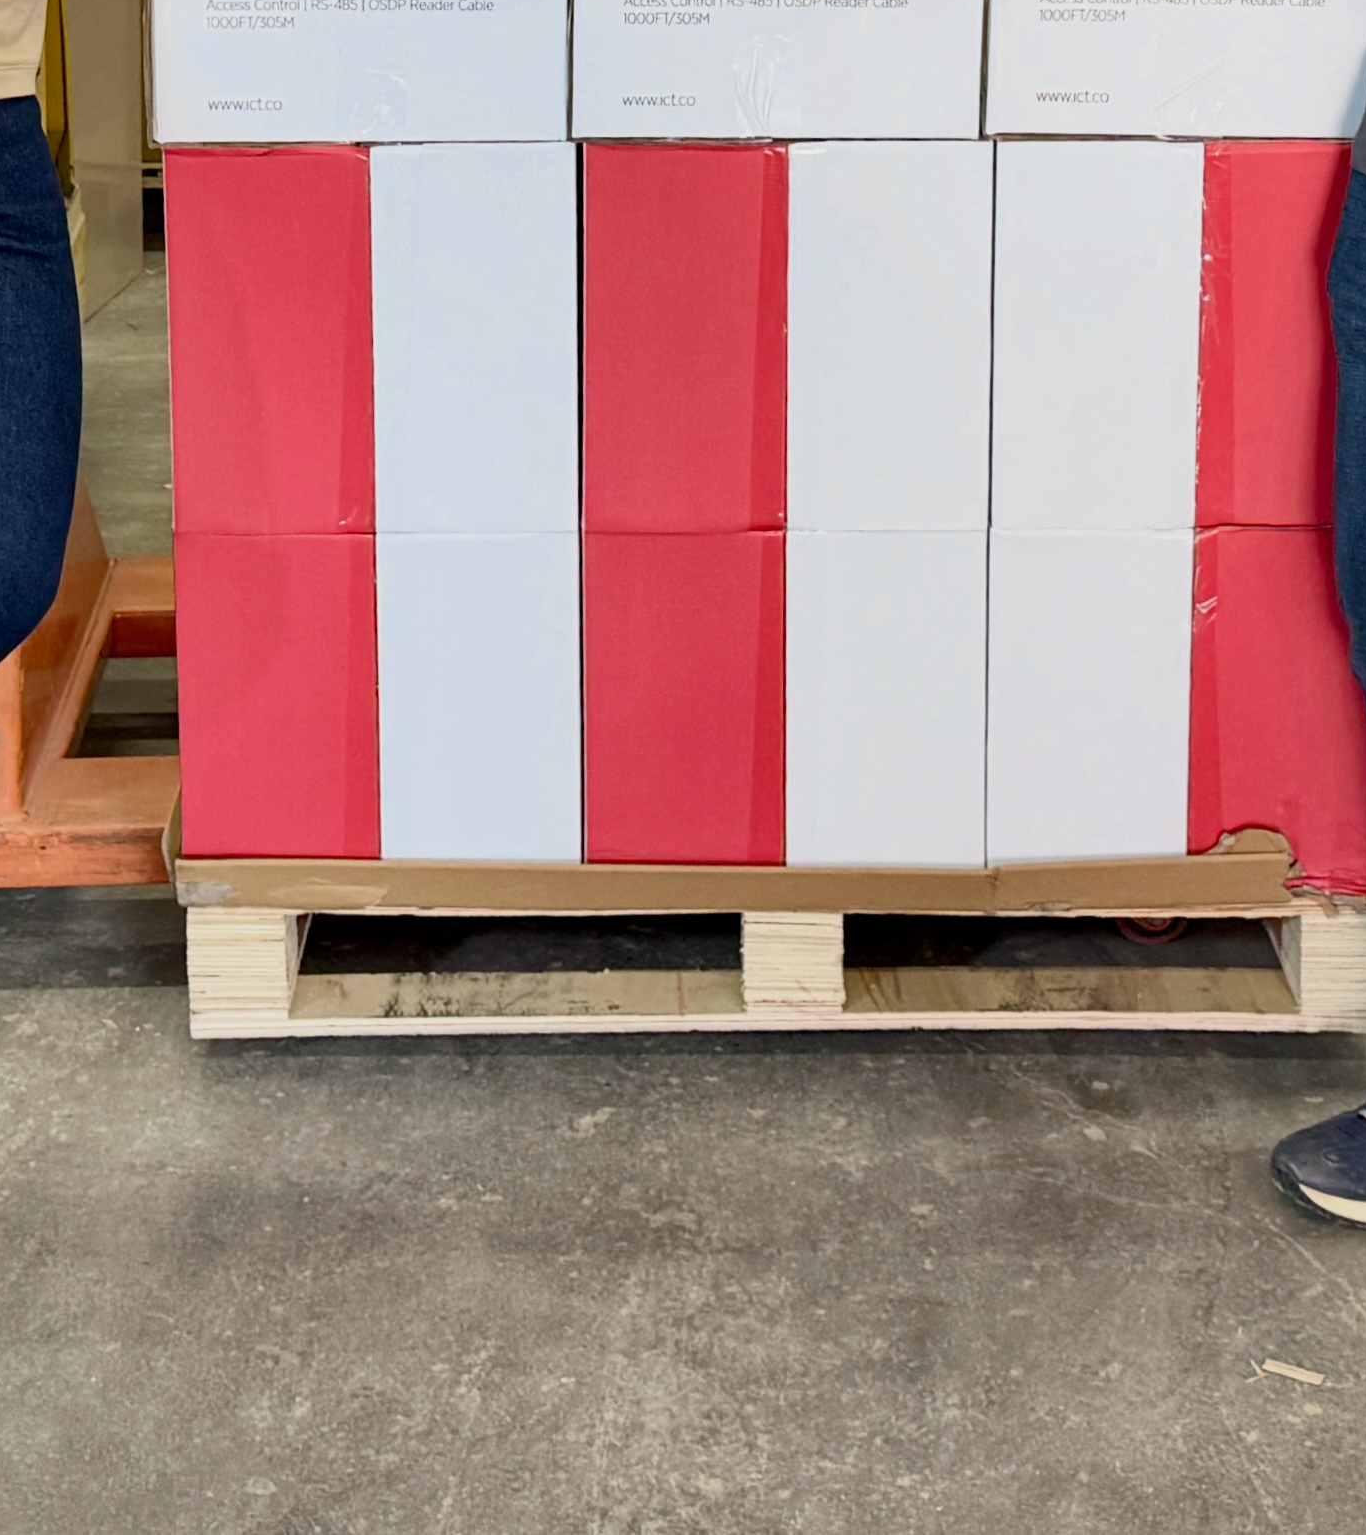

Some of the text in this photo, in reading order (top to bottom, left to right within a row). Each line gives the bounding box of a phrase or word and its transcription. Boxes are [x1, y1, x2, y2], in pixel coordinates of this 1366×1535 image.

[206, 15, 295, 30] 1000FT/305M
[623, 12, 710, 26] 1000FT/305M
[1040, 9, 1126, 23] 1000FT/305M
[622, 93, 696, 107] www.ict.co
[1036, 90, 1109, 104] www.ict.co
[208, 97, 283, 112] www.ict.co
